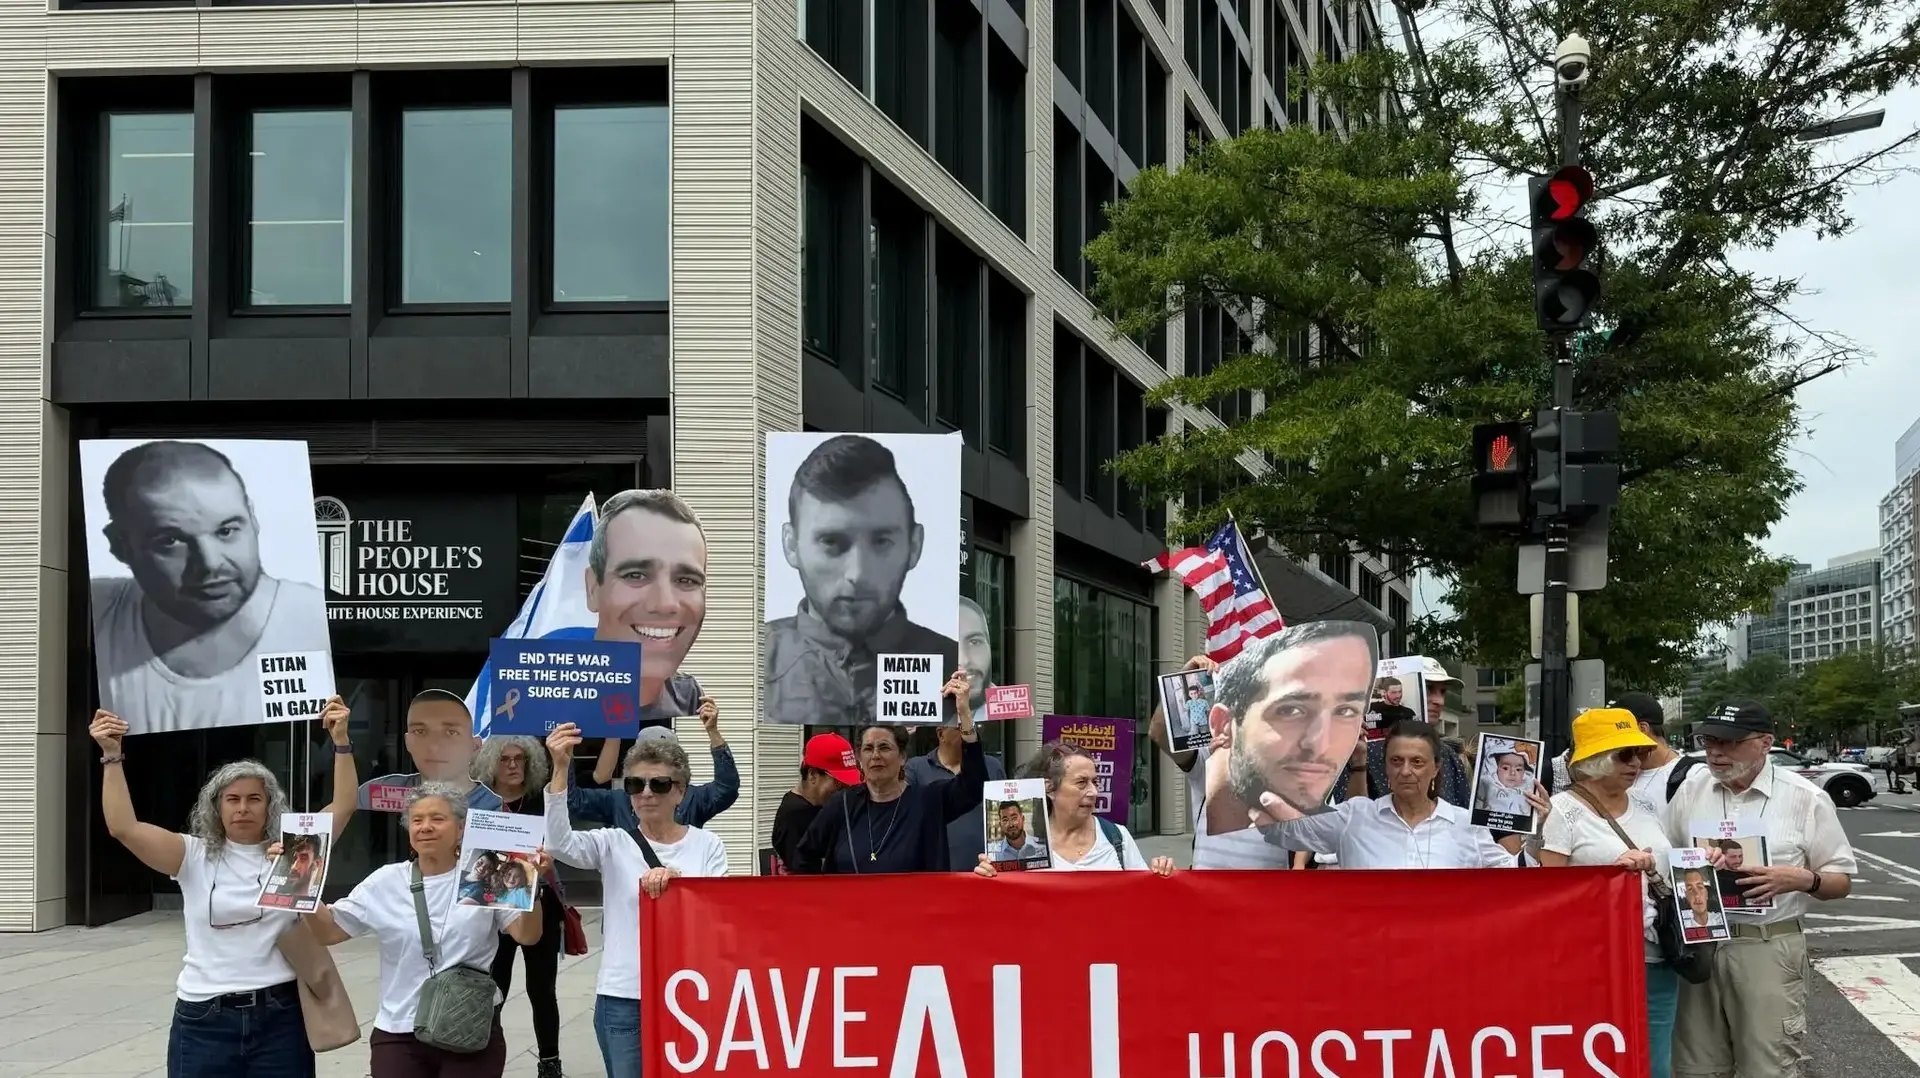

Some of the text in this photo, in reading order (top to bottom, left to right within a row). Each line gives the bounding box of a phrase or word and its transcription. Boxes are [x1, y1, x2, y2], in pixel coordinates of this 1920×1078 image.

[357, 520, 412, 542] THE
[357, 546, 483, 569] PEOPLE'S
[357, 573, 449, 596] HOUSE
[326, 607, 483, 620] HITE HOUSE EXPERIENCE
[260, 655, 307, 673] EITAN
[519, 652, 610, 667] END THE WAR
[883, 657, 931, 673] MATAN
[498, 668, 632, 684] FREE THE HOSTAGES
[263, 678, 307, 695] STILL
[527, 686, 598, 700] SURGE AID
[883, 679, 920, 695] STILL
[266, 701, 283, 718] IN
[883, 701, 938, 717] IN GAZA
[384, 786, 409, 798] דיין
[663, 966, 879, 1073] SAVE
